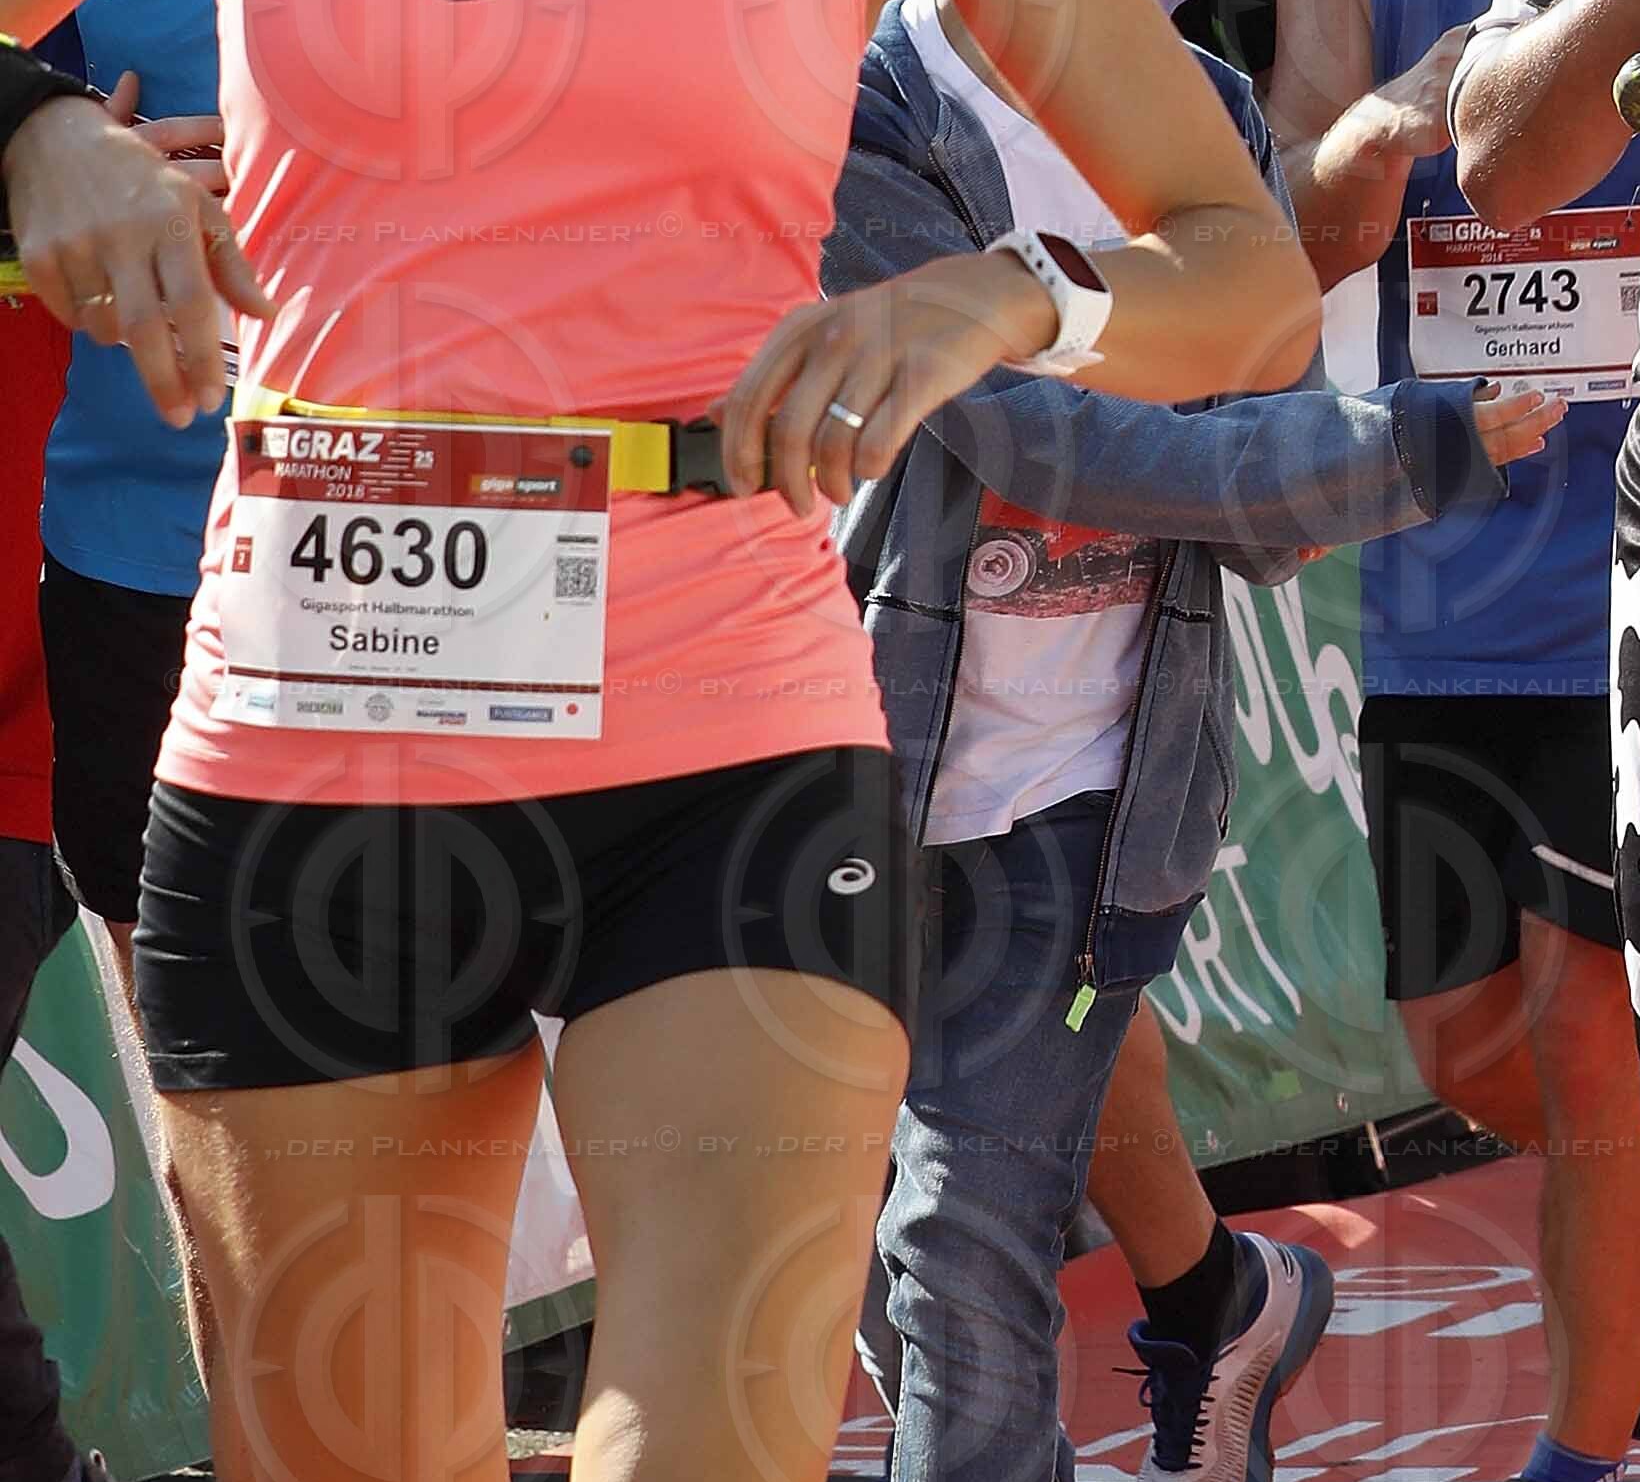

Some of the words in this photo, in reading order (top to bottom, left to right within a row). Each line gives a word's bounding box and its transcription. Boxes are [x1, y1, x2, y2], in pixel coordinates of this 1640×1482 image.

[1464, 268, 1580, 317] 2743
[1485, 337, 1561, 357] Gerhard
[290, 430, 384, 462] GRAZ
[274, 462, 351, 480] MARATHON
[325, 484, 365, 499] 2018
[290, 514, 488, 590] 4630
[300, 598, 368, 616] Gigasport
[371, 601, 475, 618] Halbmarathon
[330, 625, 440, 655] Sabine
